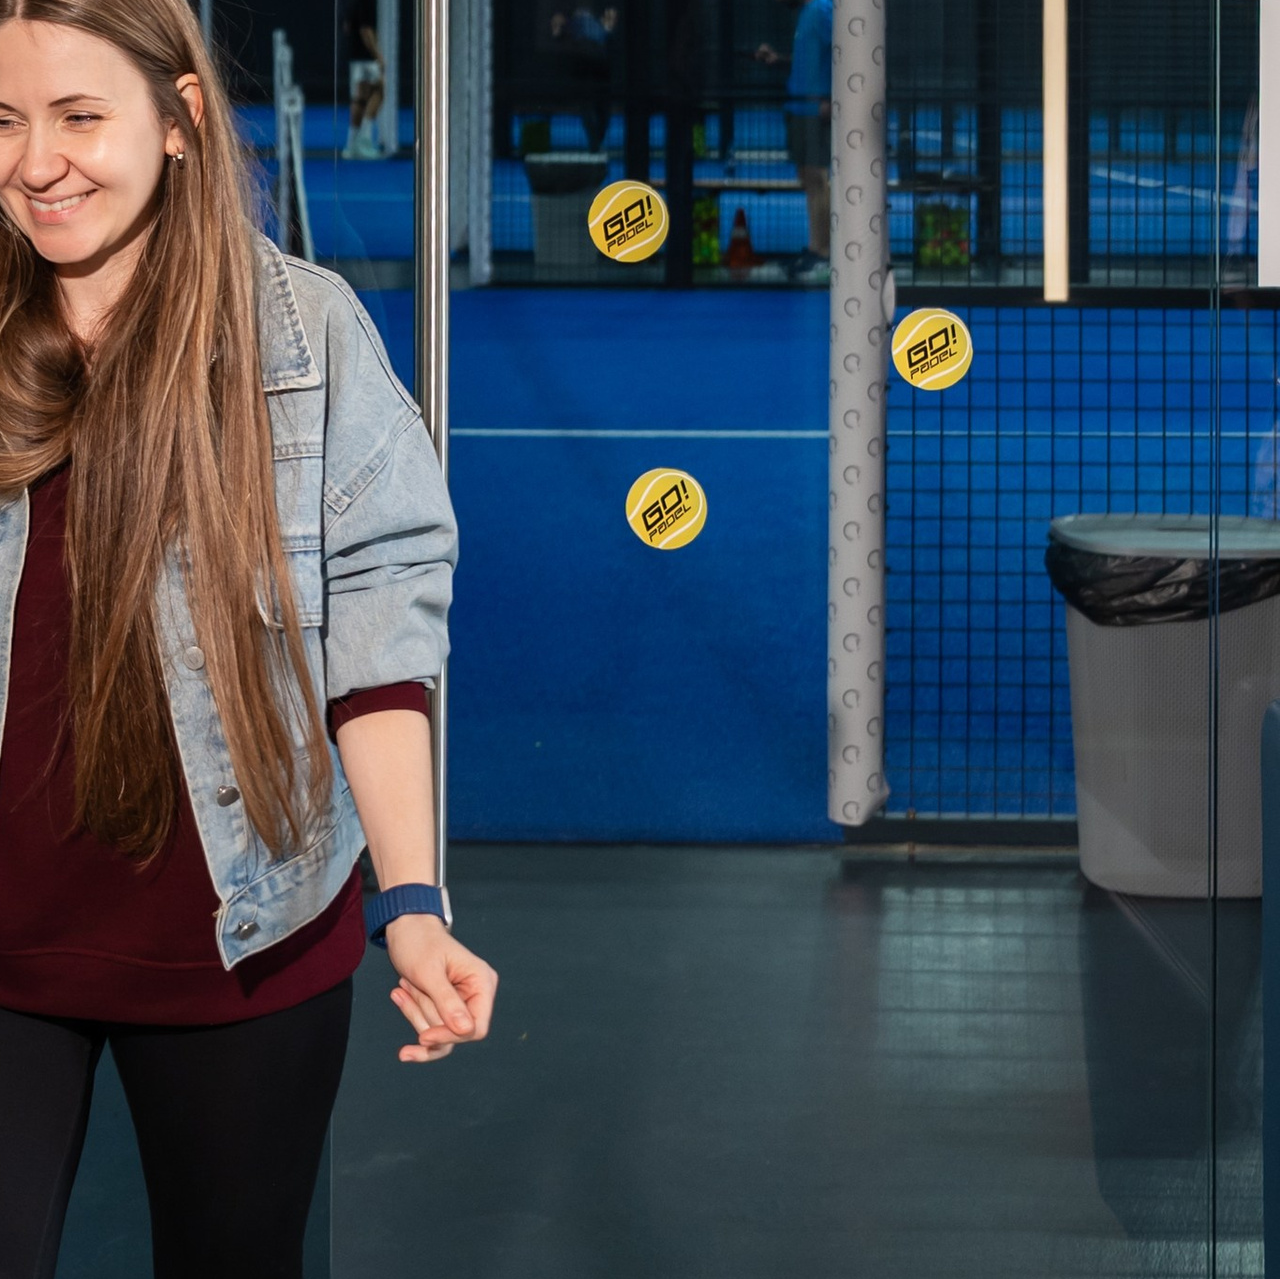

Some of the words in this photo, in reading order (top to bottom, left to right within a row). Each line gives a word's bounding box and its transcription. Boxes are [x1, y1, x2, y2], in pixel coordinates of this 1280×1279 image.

[603, 195, 653, 241] GO!
[907, 323, 957, 369] GO!
[642, 479, 689, 532] GO!
